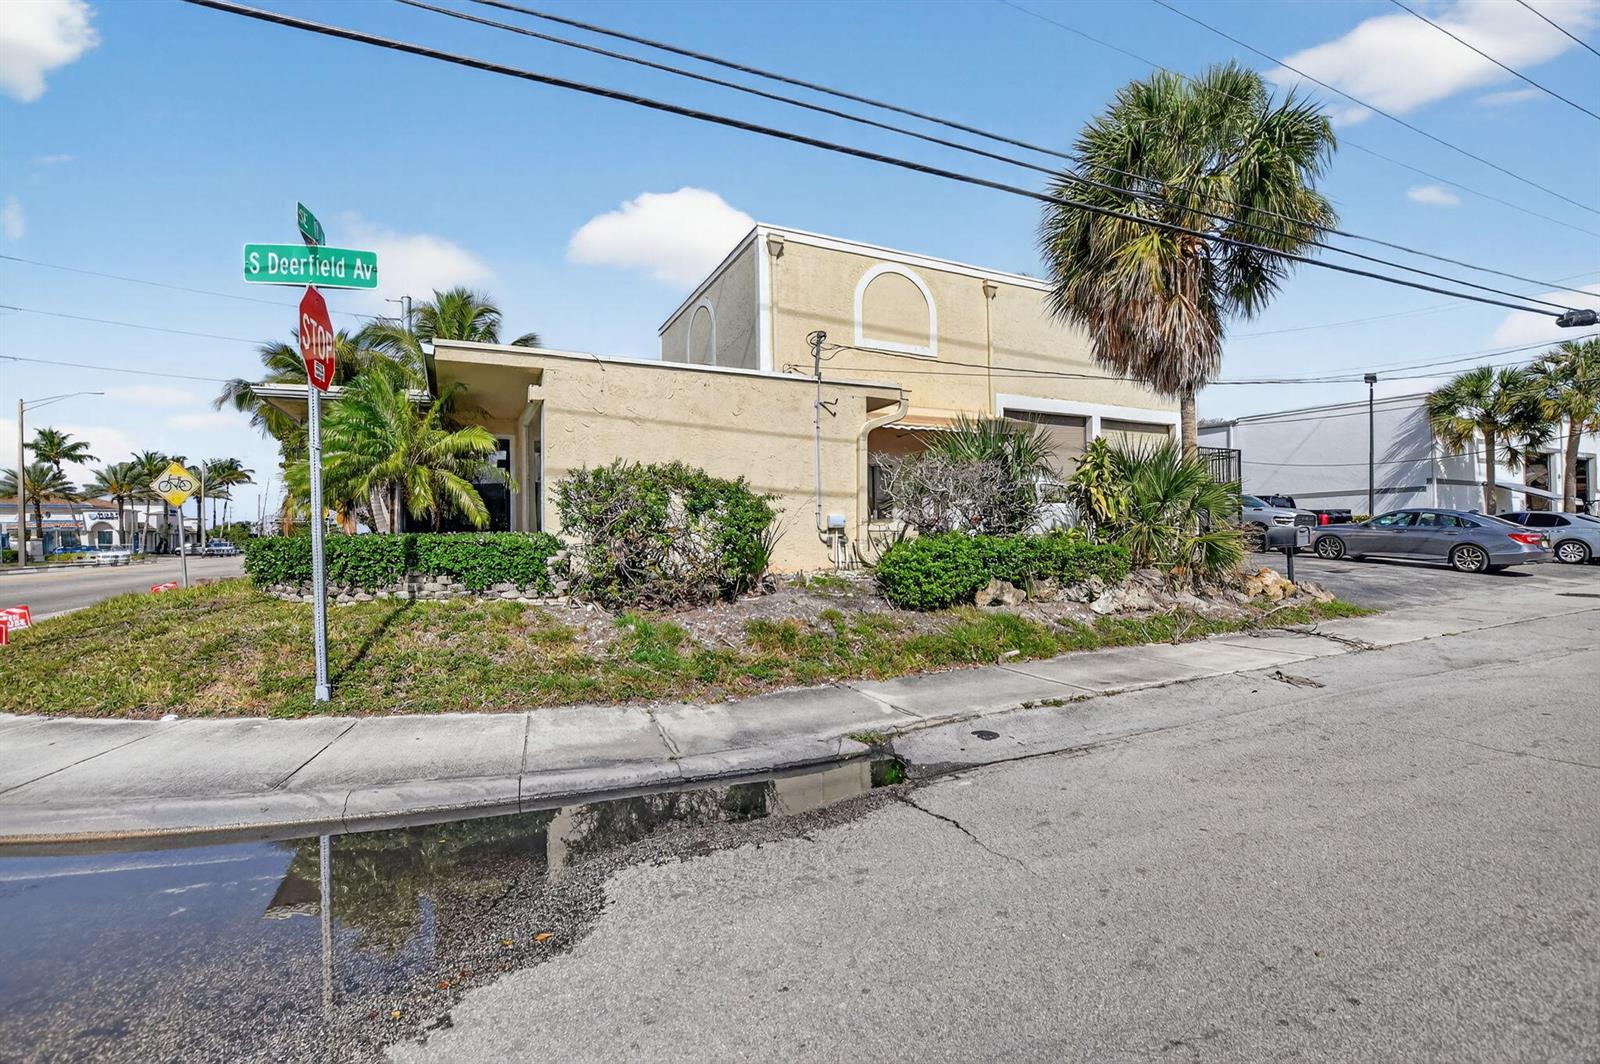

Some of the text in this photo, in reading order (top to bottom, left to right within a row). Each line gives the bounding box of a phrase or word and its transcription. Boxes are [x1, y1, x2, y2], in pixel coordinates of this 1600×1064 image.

[249, 251, 373, 280] S Deerfield Av
[302, 312, 332, 364] STOP
